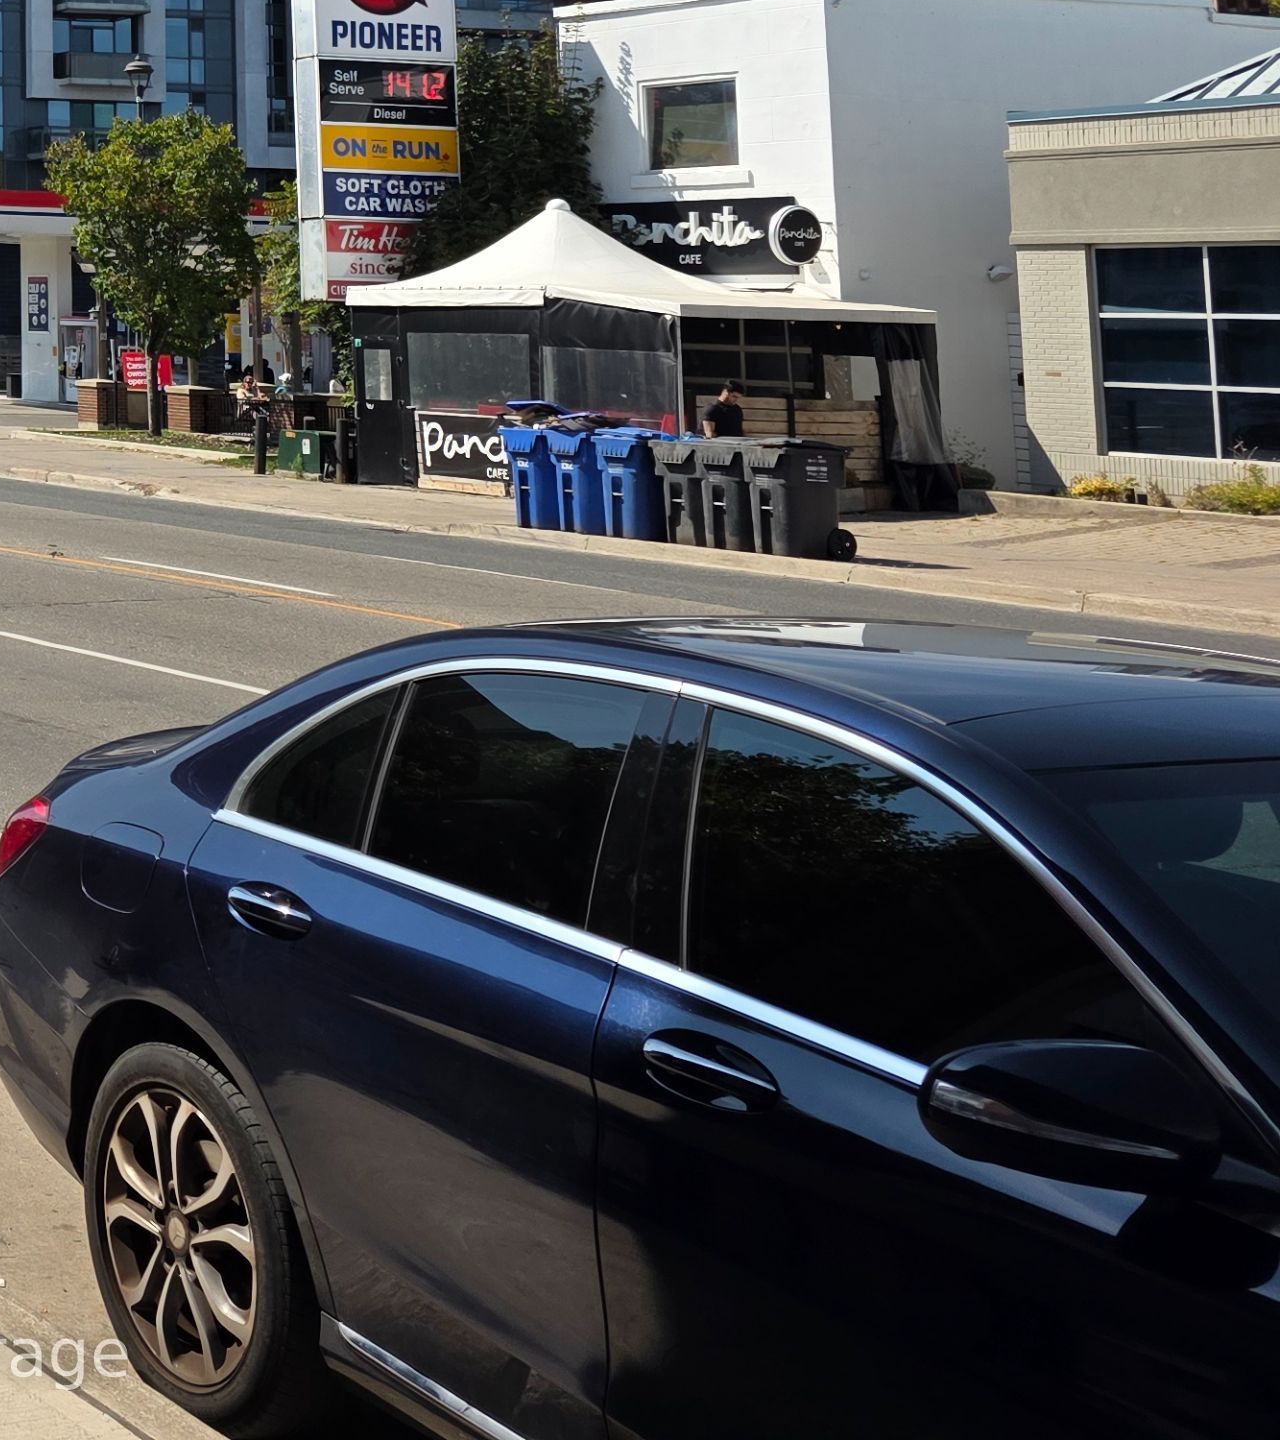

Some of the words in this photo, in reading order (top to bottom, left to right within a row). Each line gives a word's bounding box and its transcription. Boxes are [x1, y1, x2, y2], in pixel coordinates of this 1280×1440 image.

[331, 19, 442, 53] PIONEER
[333, 69, 358, 82] Self
[329, 82, 365, 95] Serve
[373, 107, 406, 120] Diesel
[333, 137, 367, 158] ON
[371, 143, 388, 155] the
[392, 140, 441, 161] RUN
[335, 177, 382, 194] SOFT
[344, 197, 382, 212] CAR
[338, 224, 376, 250] Tim
[679, 254, 703, 265] CAFE
[486, 467, 510, 481] CAFE
